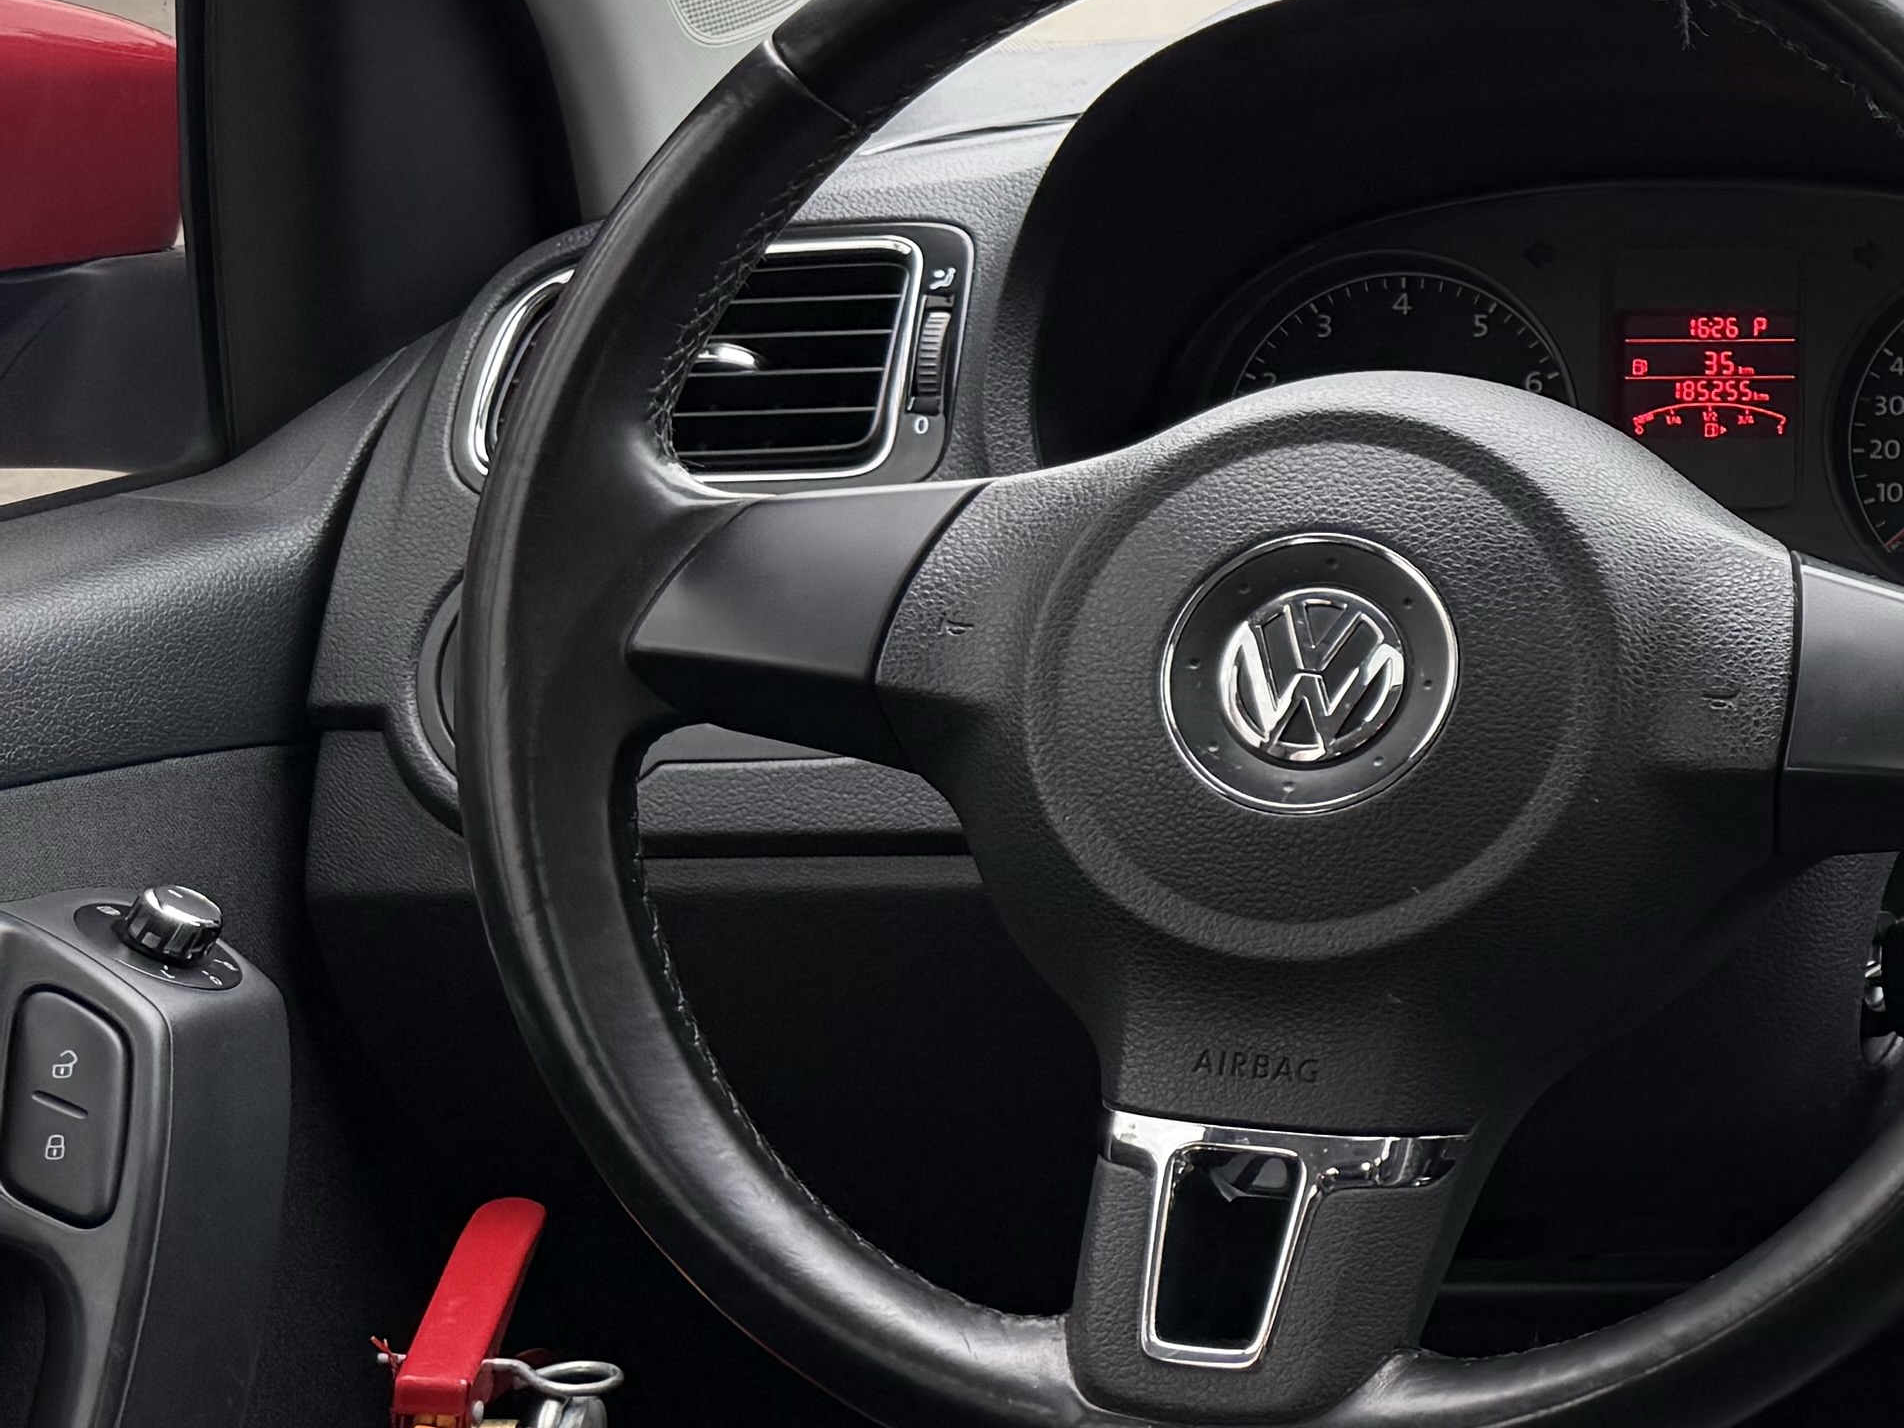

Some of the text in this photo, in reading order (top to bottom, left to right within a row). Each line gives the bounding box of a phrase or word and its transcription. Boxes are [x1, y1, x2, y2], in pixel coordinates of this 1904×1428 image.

[1391, 291, 1413, 316] 4
[1316, 314, 1333, 338] 3
[1472, 314, 1489, 338] 5
[1753, 316, 1768, 337] P
[1704, 350, 1755, 375] 35 km
[1524, 372, 1543, 395] 6
[1675, 380, 1770, 401] 185255 km
[1869, 439, 1901, 460] 20
[1876, 482, 1904, 503] 10
[1191, 1048, 1321, 1085] AIRBAG
